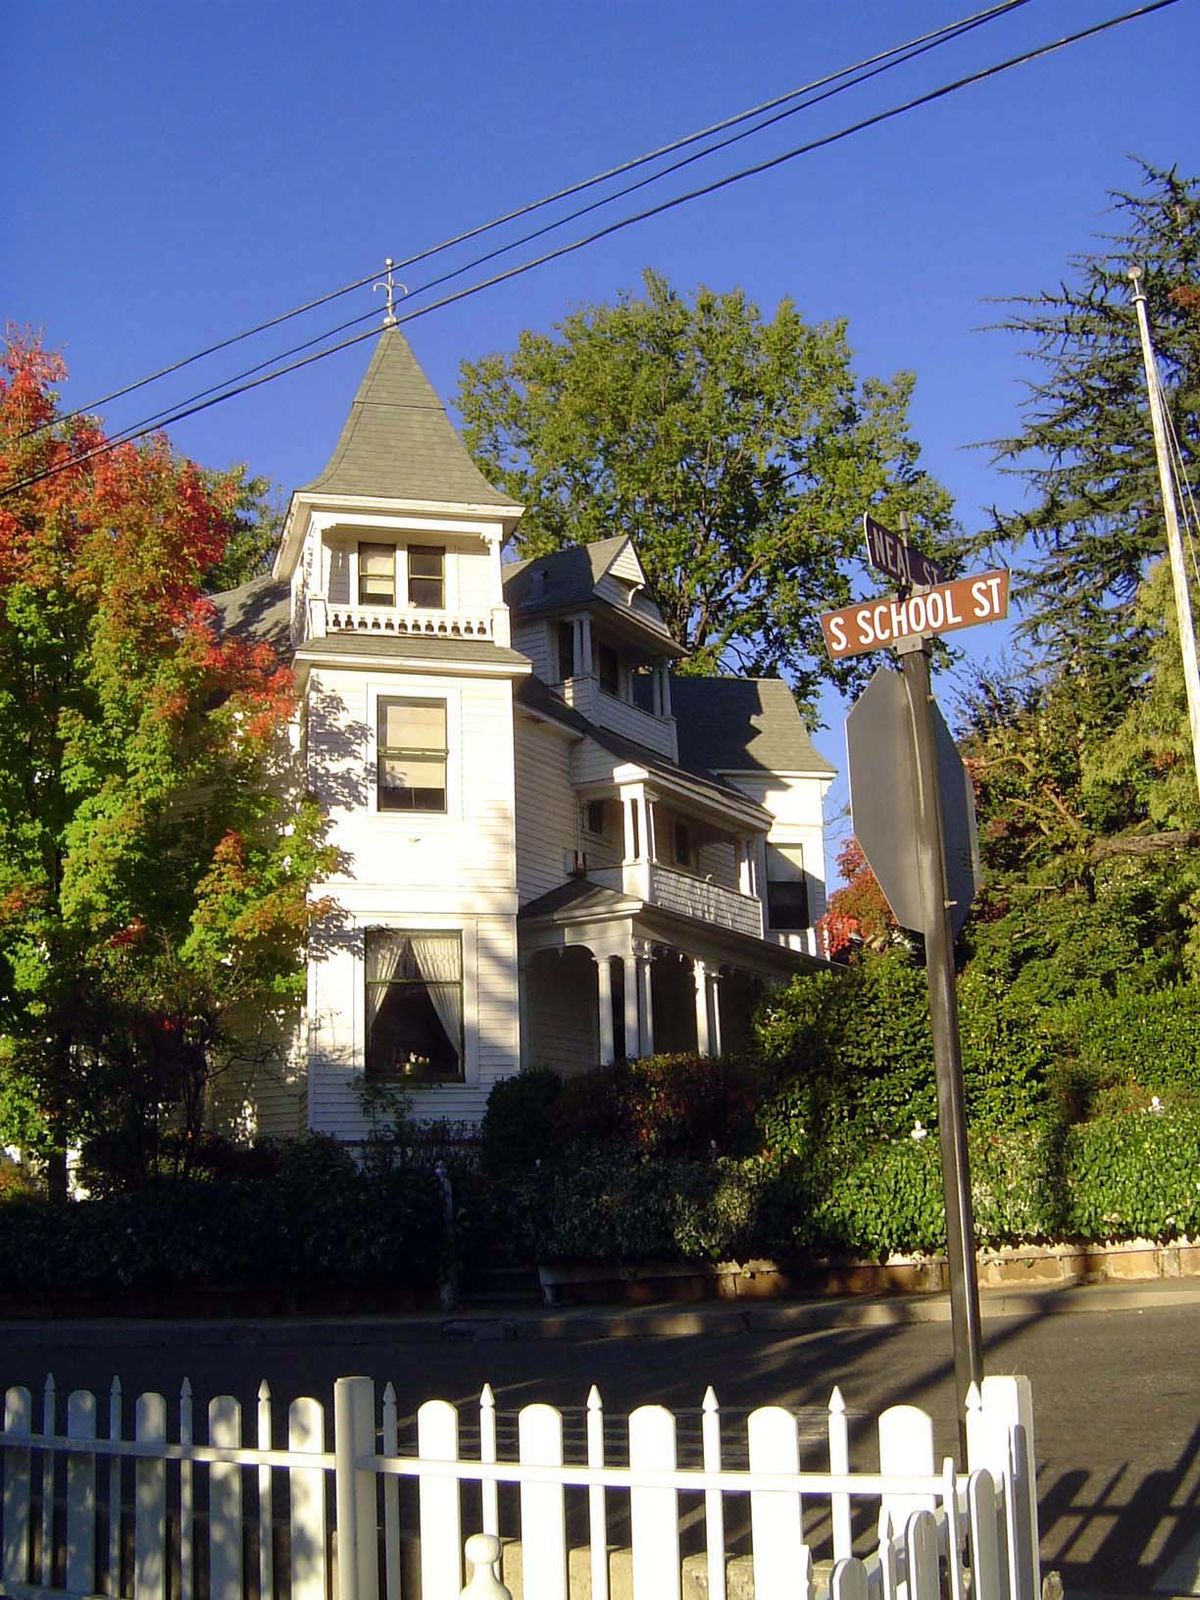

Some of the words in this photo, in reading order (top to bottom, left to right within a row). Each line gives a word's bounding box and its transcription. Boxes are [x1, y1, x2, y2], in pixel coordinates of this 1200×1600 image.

[923, 561, 939, 585] ST
[856, 589, 963, 645] SCHOOL
[971, 577, 1001, 618] ST
